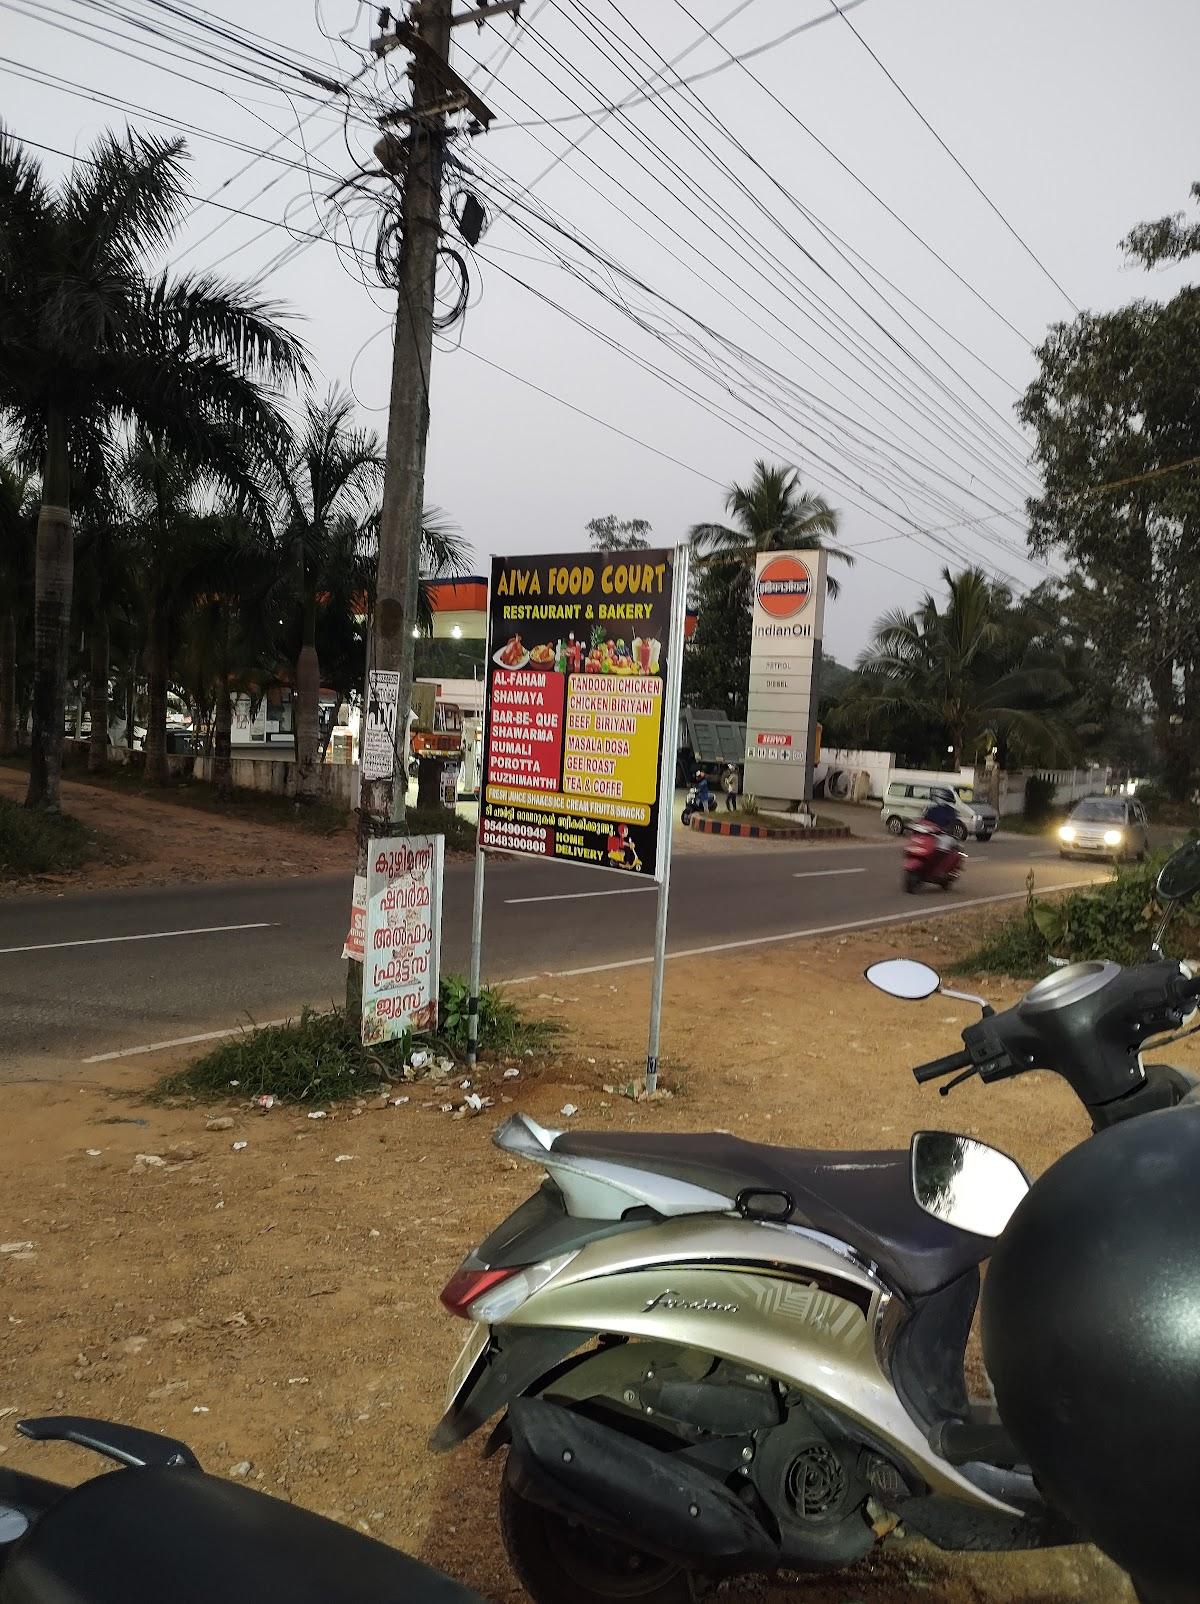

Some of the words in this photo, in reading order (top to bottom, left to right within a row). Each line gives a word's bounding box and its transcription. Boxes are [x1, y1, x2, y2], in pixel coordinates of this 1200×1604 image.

[497, 568, 541, 596] AIWA
[548, 566, 595, 596] FOOD
[601, 563, 666, 595] COURT
[503, 604, 581, 620] RESTAURANT
[585, 604, 594, 620] &
[598, 603, 654, 620] BAKERY
[754, 623, 812, 638] IndianOil
[494, 671, 546, 688] AL-FAHAM
[570, 676, 615, 693] TANDOORI
[618, 678, 660, 695] CHICKEN
[493, 689, 544, 706] SHAWAYA
[569, 696, 609, 712] CHICKEN
[611, 698, 652, 715] BIRIYANI
[535, 712, 558, 728] QUE
[568, 714, 591, 730] BEEF
[595, 716, 636, 734] BIRIYANI
[491, 725, 554, 743] SHAWARMA
[762, 734, 787, 745] SERVO
[491, 740, 532, 757] RUMALI
[567, 735, 602, 753] MASALA
[605, 739, 630, 756] DOSA
[490, 755, 541, 773] POROTTA
[566, 755, 584, 771] GEE
[585, 757, 615, 775] ROAST
[490, 771, 557, 790] KUZHIMANTHI
[565, 775, 584, 792] TEA
[584, 778, 592, 793] &
[593, 779, 622, 797] COFFE
[488, 787, 508, 801] FRESH
[616, 805, 646, 821] SNACKS
[555, 831, 585, 847] HOME
[375, 842, 434, 879] കുഴിമന്തി
[555, 843, 604, 861] DELIVERY
